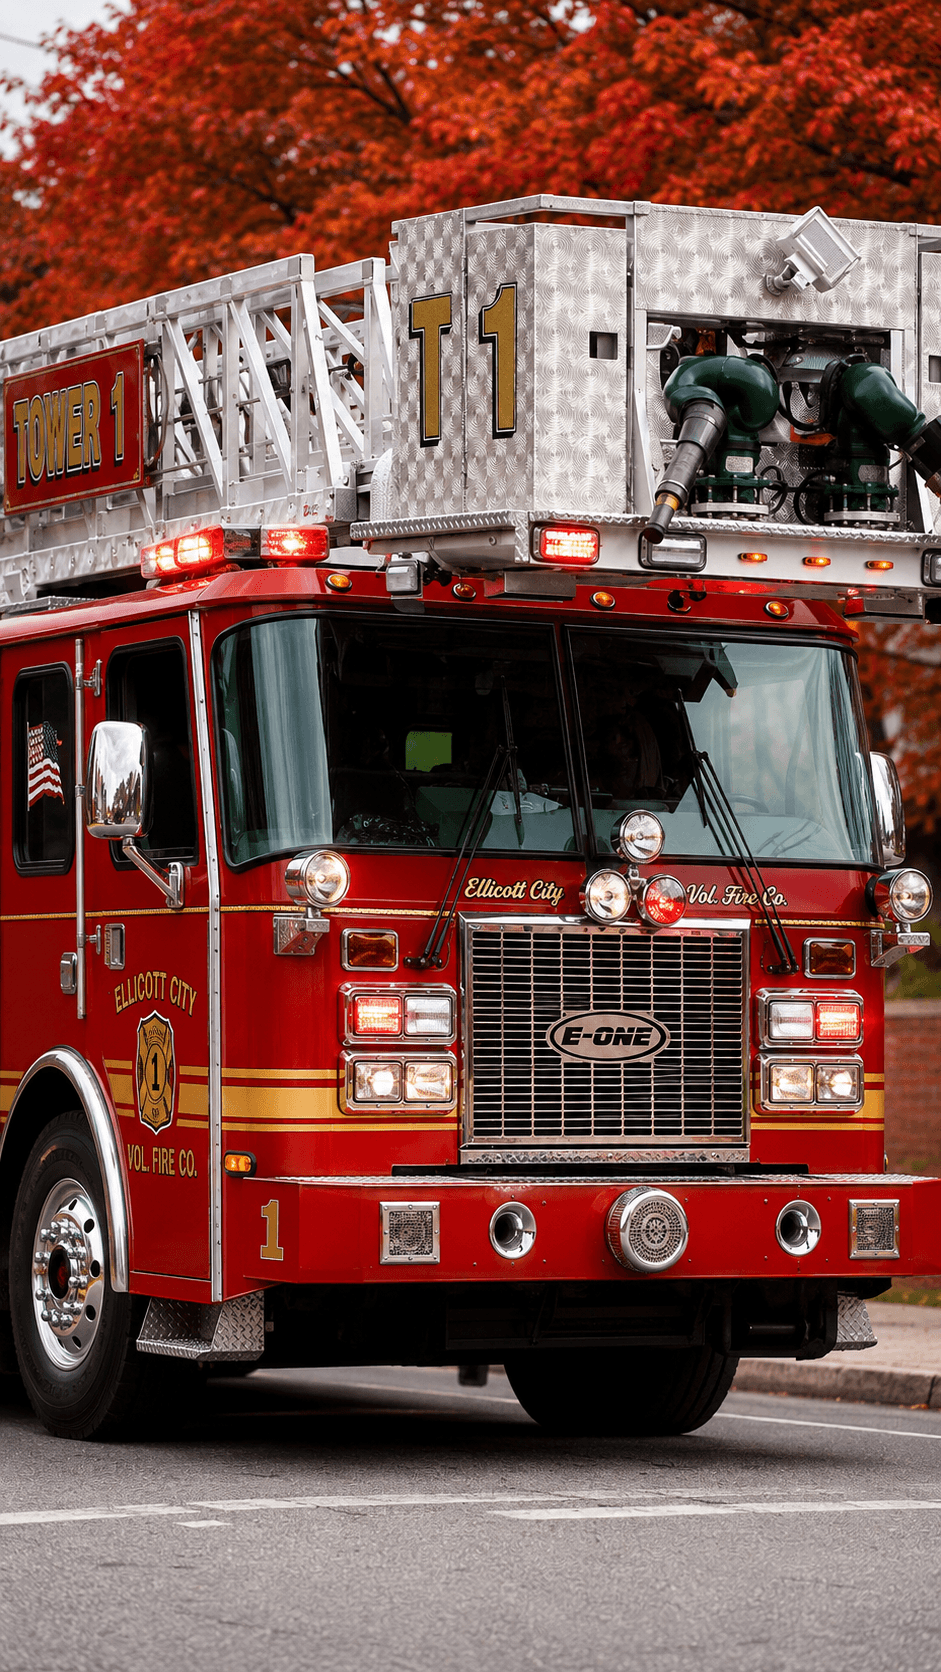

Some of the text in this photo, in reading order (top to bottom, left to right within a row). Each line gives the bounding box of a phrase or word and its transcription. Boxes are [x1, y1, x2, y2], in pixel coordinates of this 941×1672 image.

[13, 371, 125, 488] TOWER 1
[464, 877, 565, 907] Ellicott City
[686, 883, 788, 907] Vol. Fire Co.
[114, 971, 198, 1018] ELLICOTT CITY
[561, 1026, 654, 1046] E-ONE
[151, 1052, 160, 1091] 1
[127, 1143, 198, 1178] VOL. FIRE CO.
[260, 1199, 284, 1261] 1
